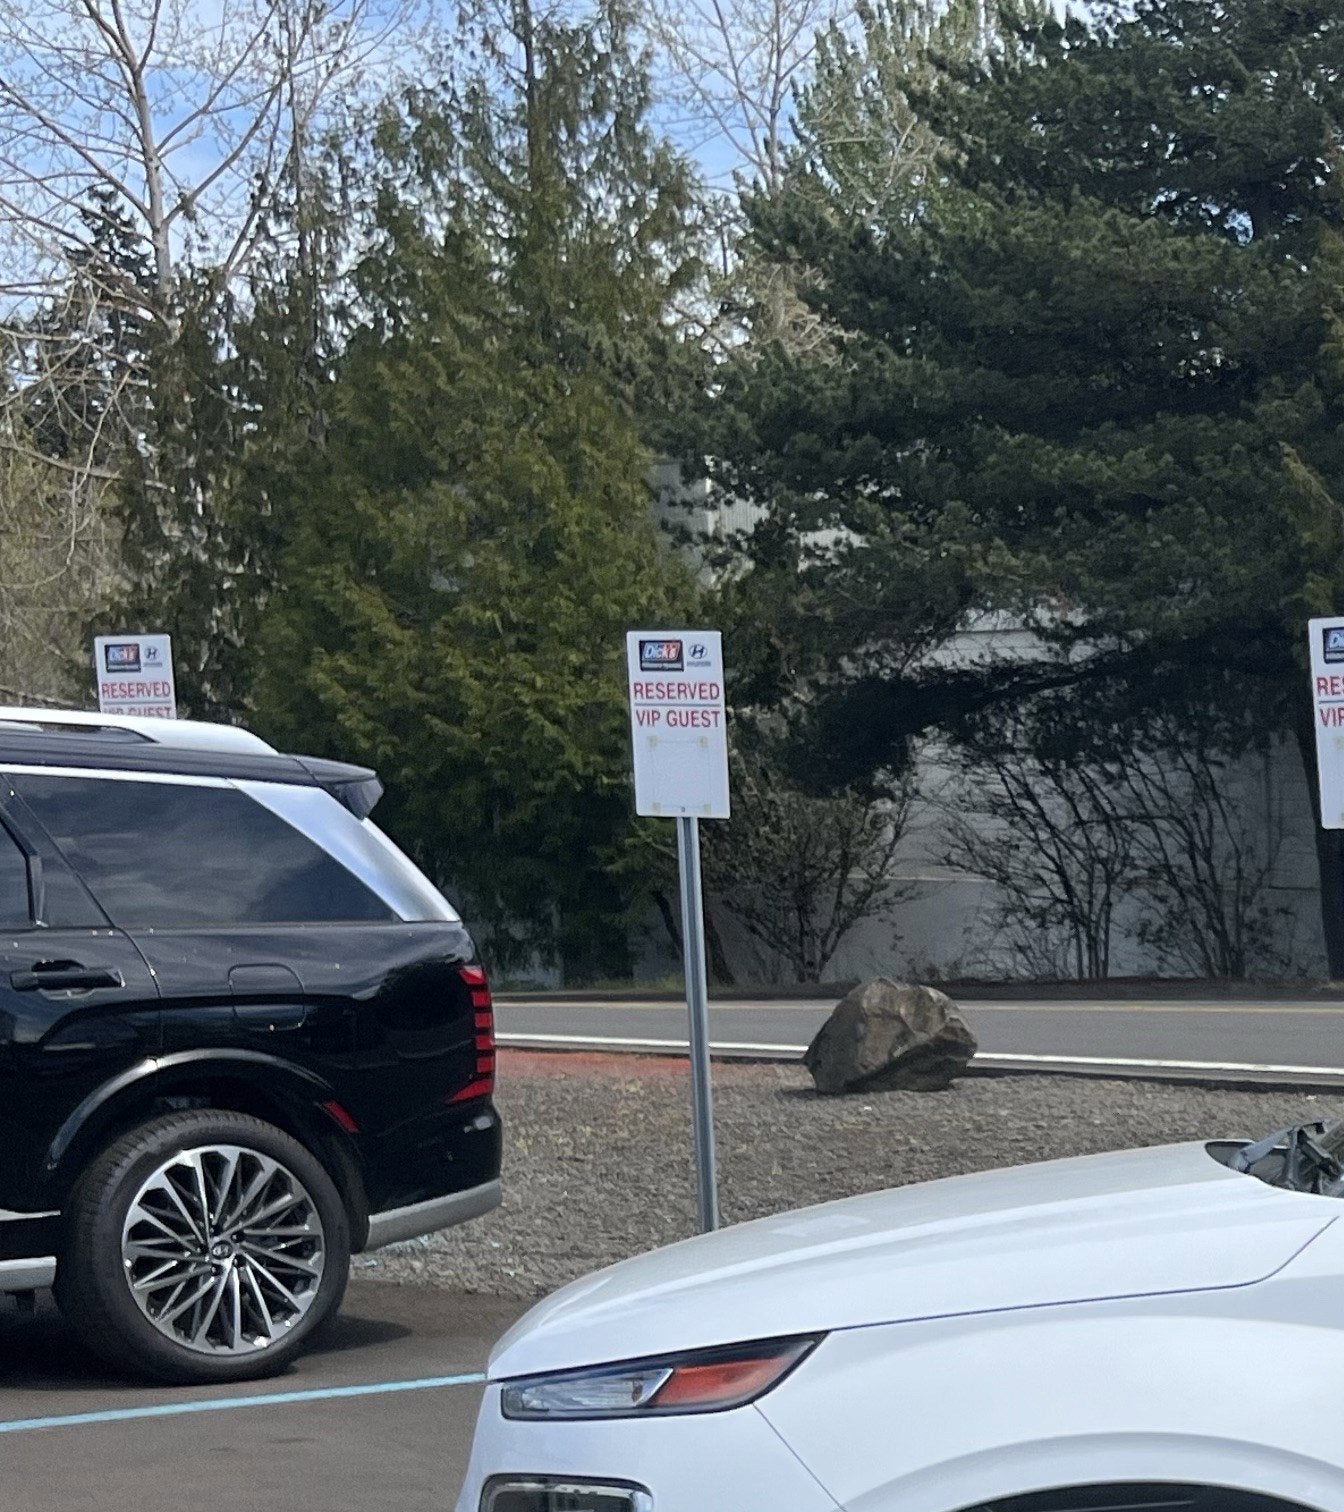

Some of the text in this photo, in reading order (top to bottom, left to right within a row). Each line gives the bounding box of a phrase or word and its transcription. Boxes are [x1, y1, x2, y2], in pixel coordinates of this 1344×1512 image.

[101, 681, 171, 698] RESERVED
[633, 682, 720, 700] RESERVED
[635, 709, 720, 727] VIP GUEST
